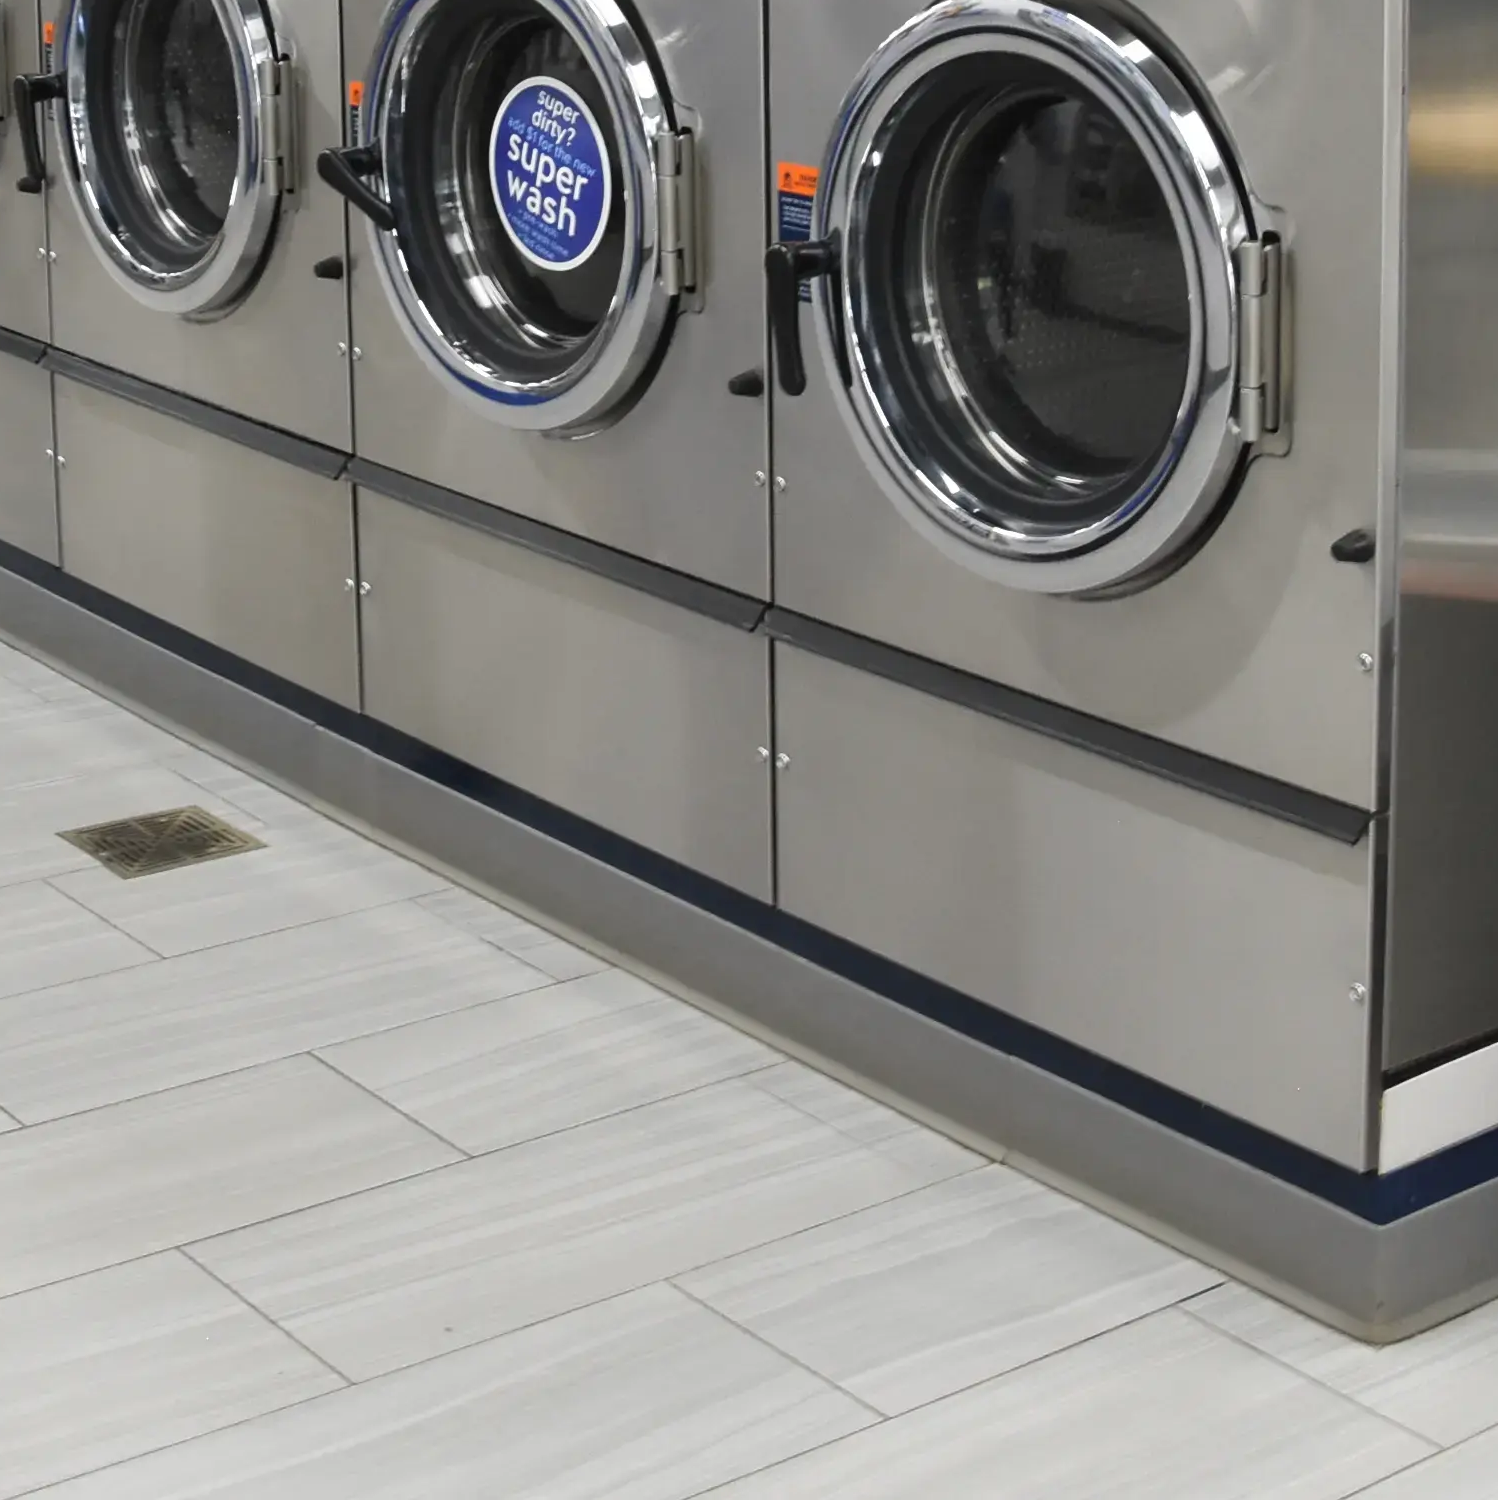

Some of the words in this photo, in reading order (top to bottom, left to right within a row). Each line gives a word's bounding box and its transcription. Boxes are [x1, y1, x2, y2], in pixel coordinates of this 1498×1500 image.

[531, 109, 577, 147] dirty?
[536, 90, 580, 125] super
[506, 133, 589, 201] super
[507, 116, 527, 135] add
[526, 125, 537, 144] $1
[537, 132, 554, 154] for
[553, 145, 572, 166] the
[572, 158, 597, 178] new
[506, 169, 577, 237] wash
